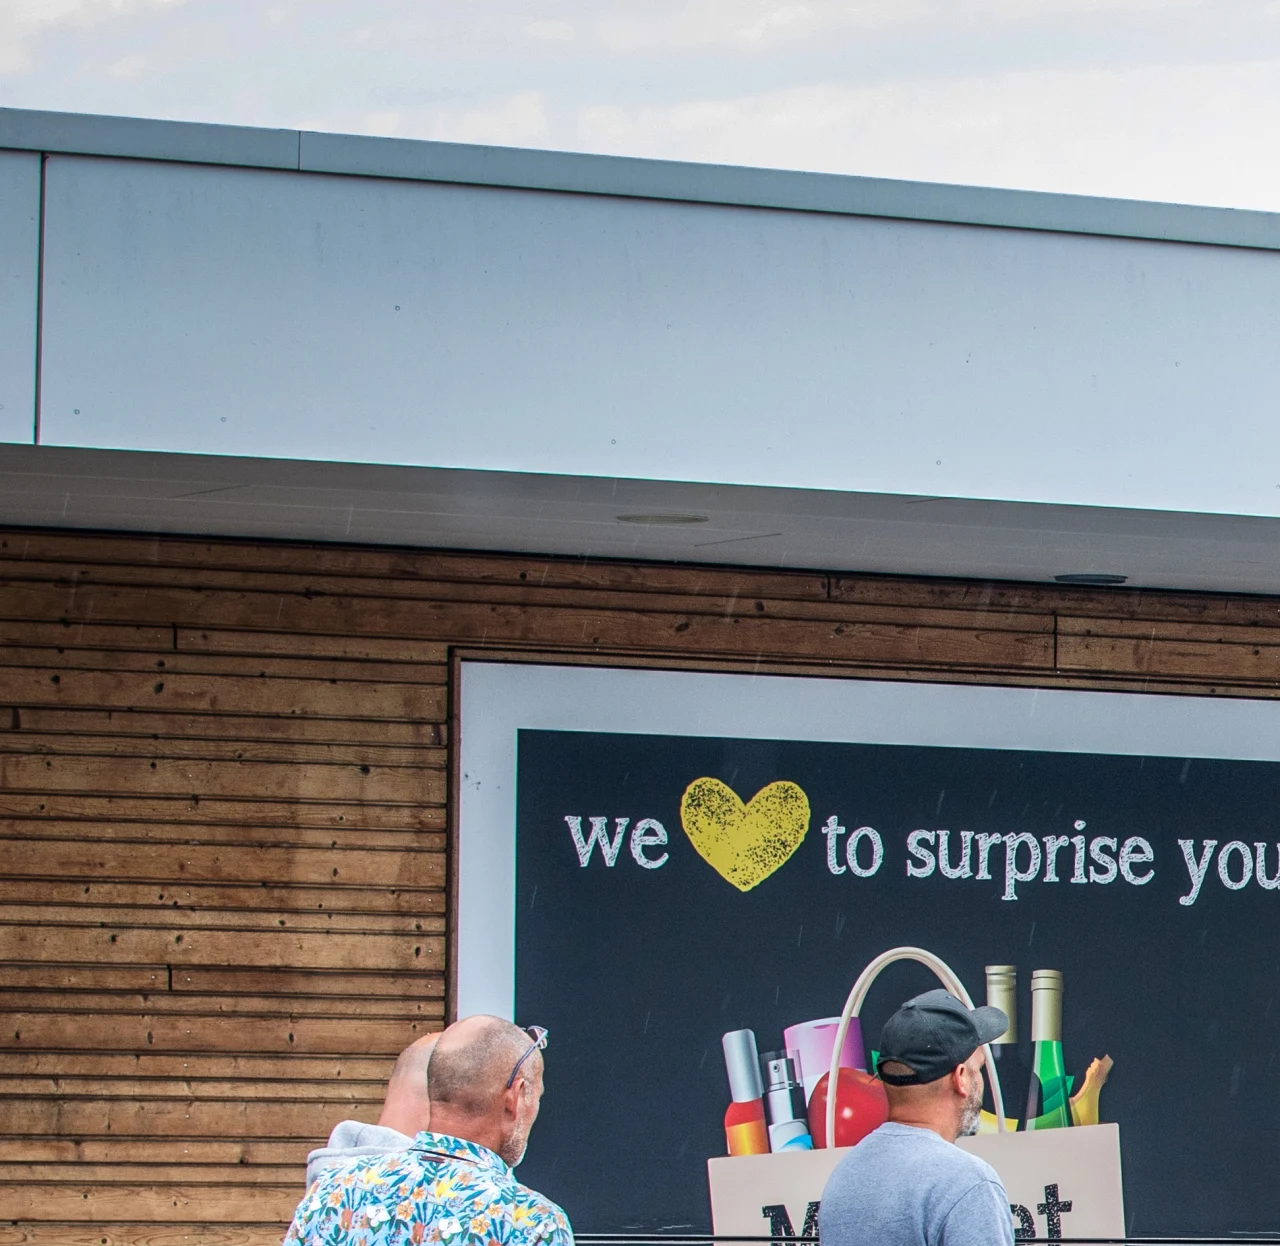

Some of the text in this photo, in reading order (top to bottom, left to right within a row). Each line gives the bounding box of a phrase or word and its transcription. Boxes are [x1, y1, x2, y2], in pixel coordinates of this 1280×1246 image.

[564, 815, 669, 869] we
[821, 815, 884, 877] to
[906, 819, 1155, 900] surprise
